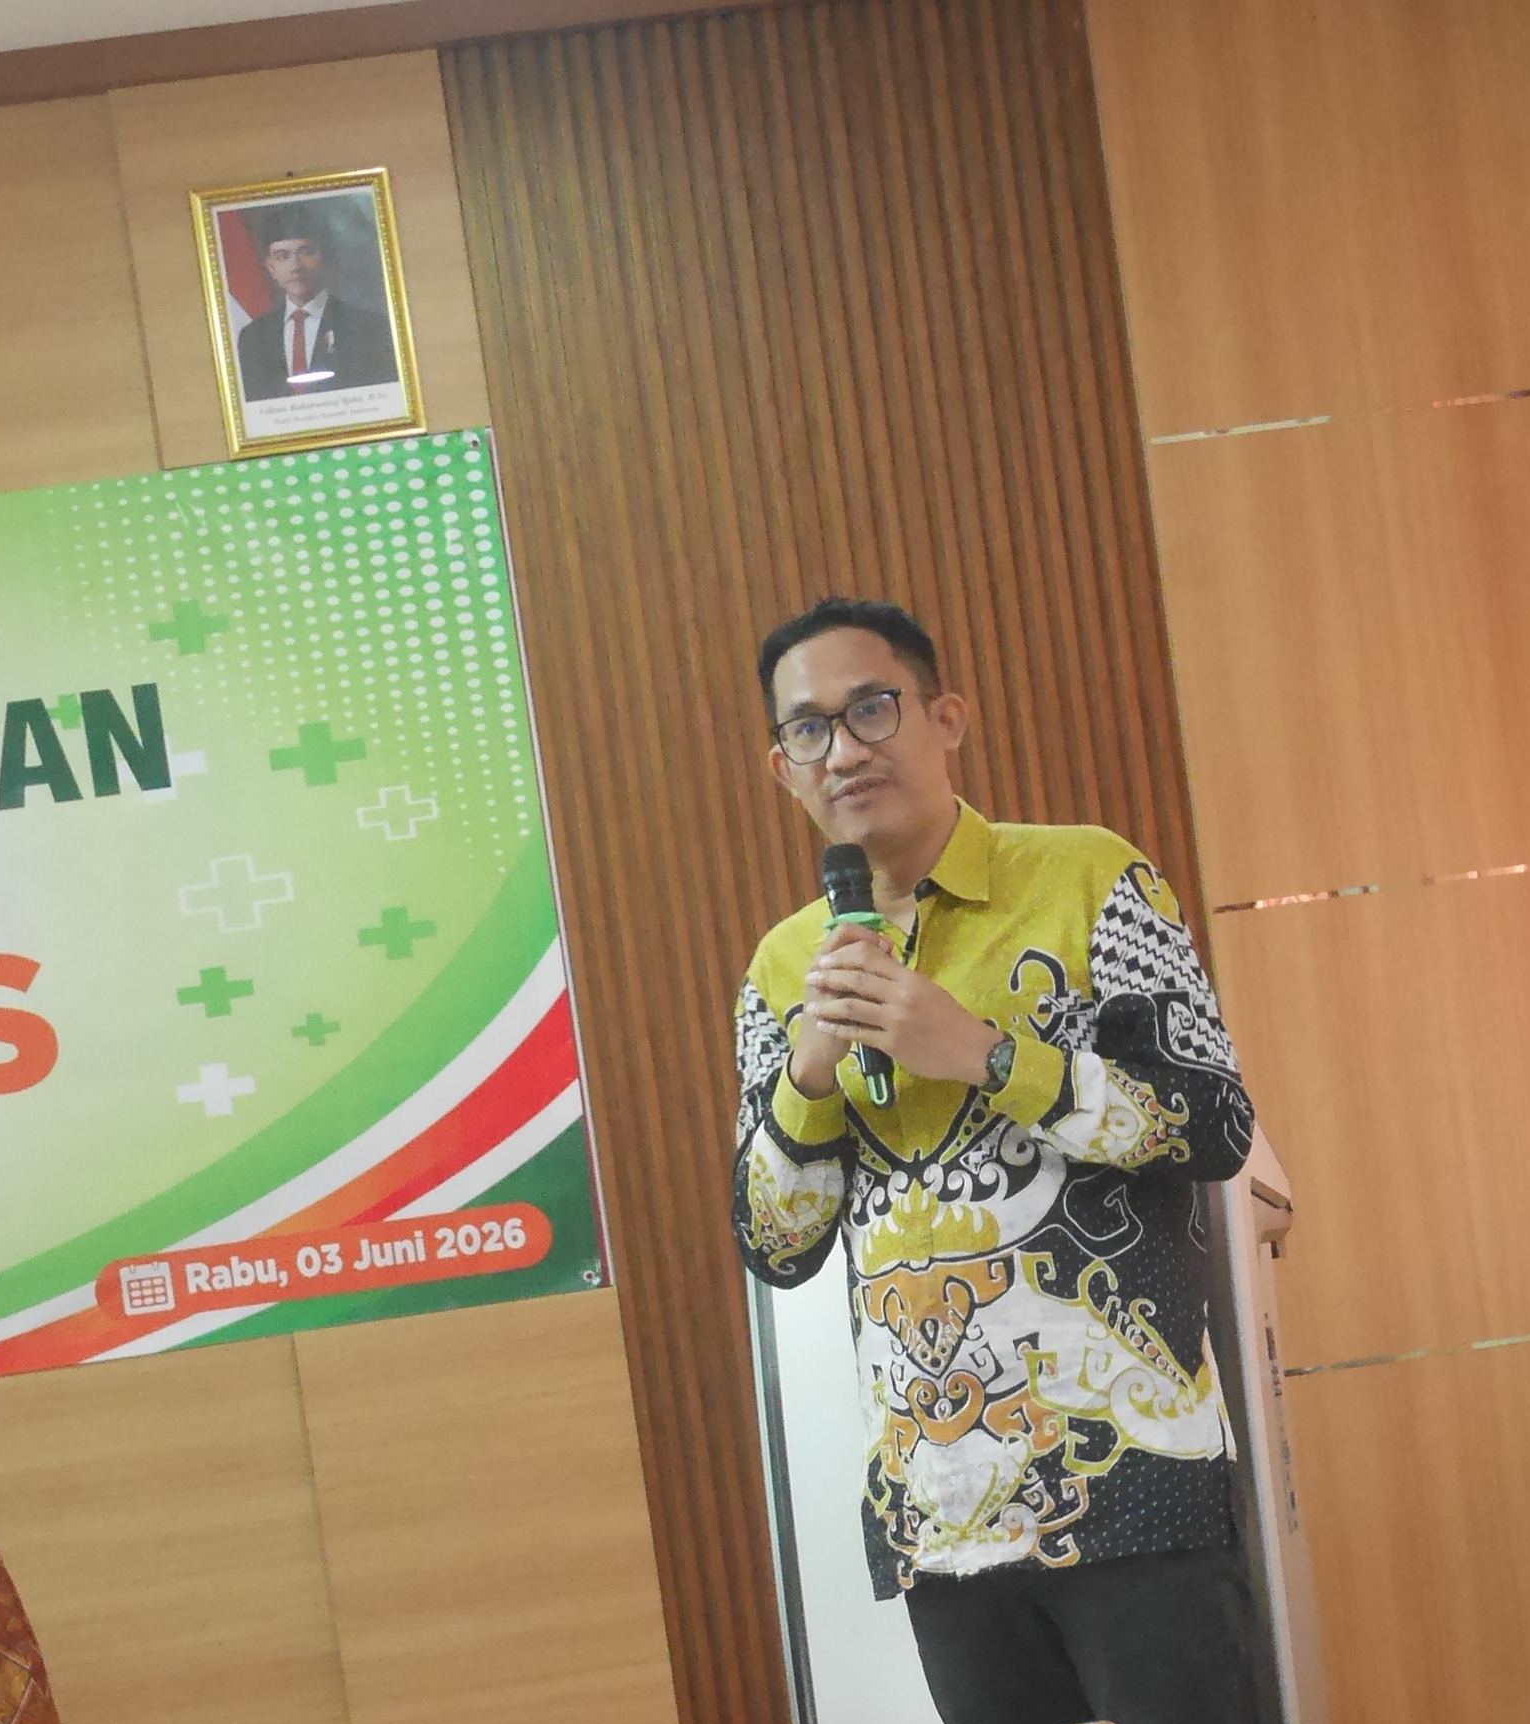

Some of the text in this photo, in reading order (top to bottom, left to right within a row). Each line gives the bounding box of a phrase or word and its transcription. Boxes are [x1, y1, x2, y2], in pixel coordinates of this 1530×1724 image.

[185, 1217, 527, 1295] Rabu, 03 Juni 2026
